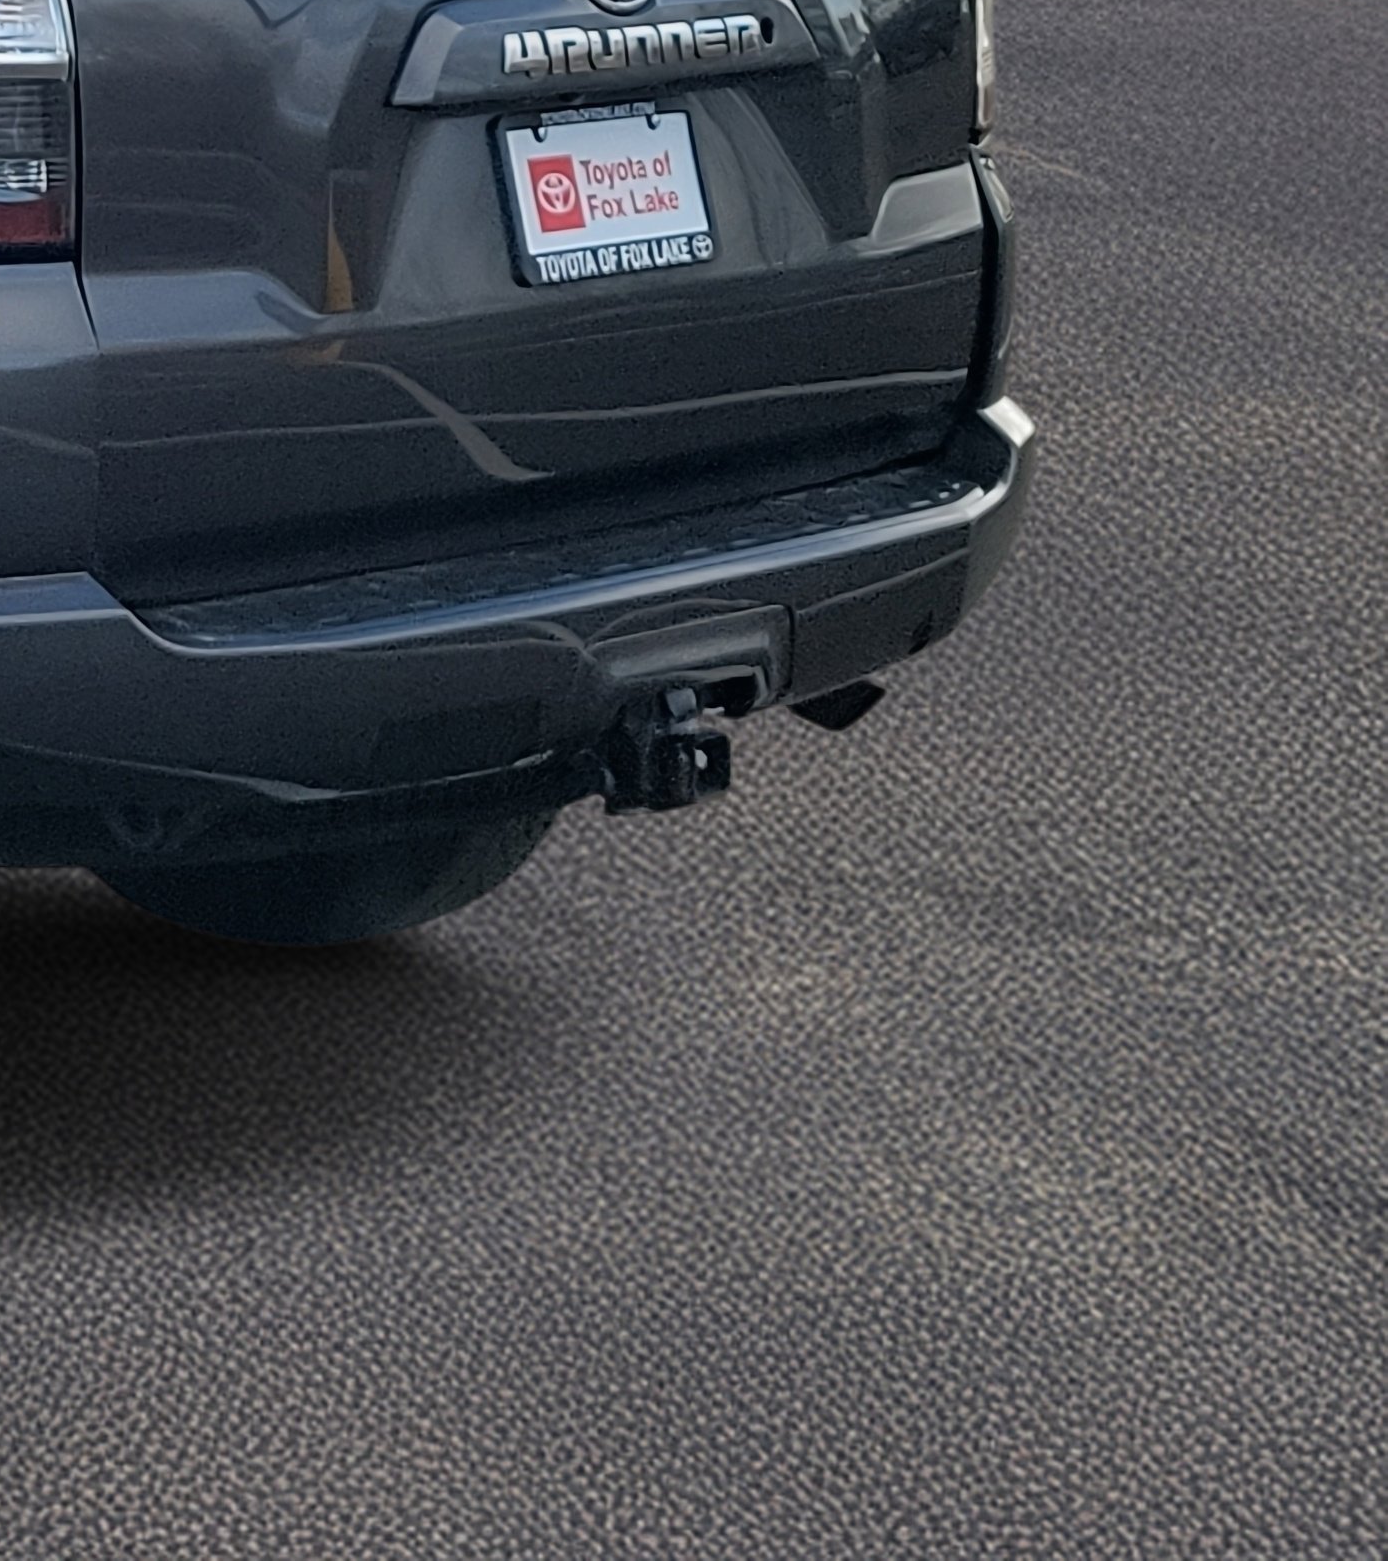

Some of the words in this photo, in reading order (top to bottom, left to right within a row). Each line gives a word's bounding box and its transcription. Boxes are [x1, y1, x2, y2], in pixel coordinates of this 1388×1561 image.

[578, 156, 648, 190] Toyota
[653, 149, 673, 177] of
[585, 194, 627, 221] Fox
[629, 186, 680, 215] Lake
[535, 250, 599, 283] TOYOTA
[597, 246, 619, 275] OF
[619, 240, 655, 271] FOX
[651, 236, 693, 267] LAKE
